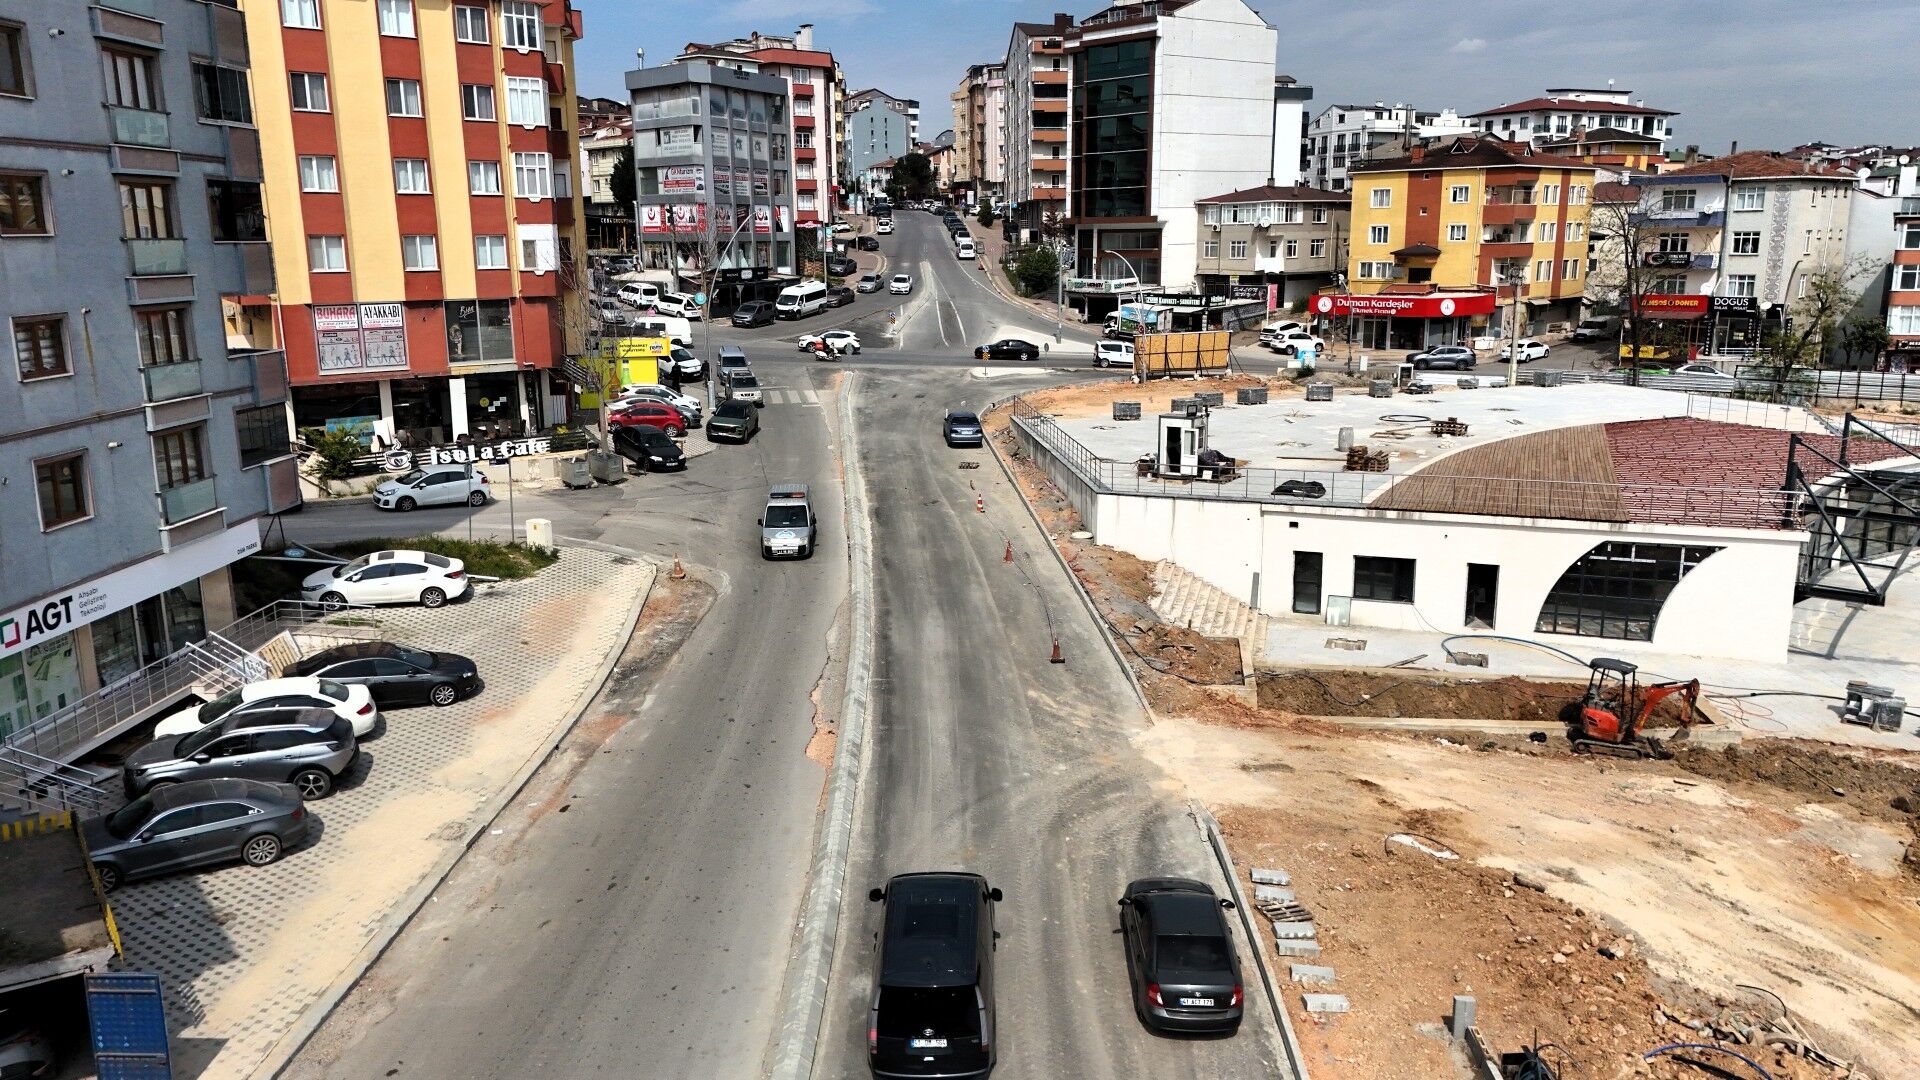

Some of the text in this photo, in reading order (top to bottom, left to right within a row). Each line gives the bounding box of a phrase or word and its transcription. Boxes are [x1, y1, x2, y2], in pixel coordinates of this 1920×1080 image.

[1337, 299, 1414, 309] Duman Kardeşler
[316, 306, 356, 319] BUHARA
[364, 305, 400, 319] AYAKKABI
[25, 595, 73, 640] AGT
